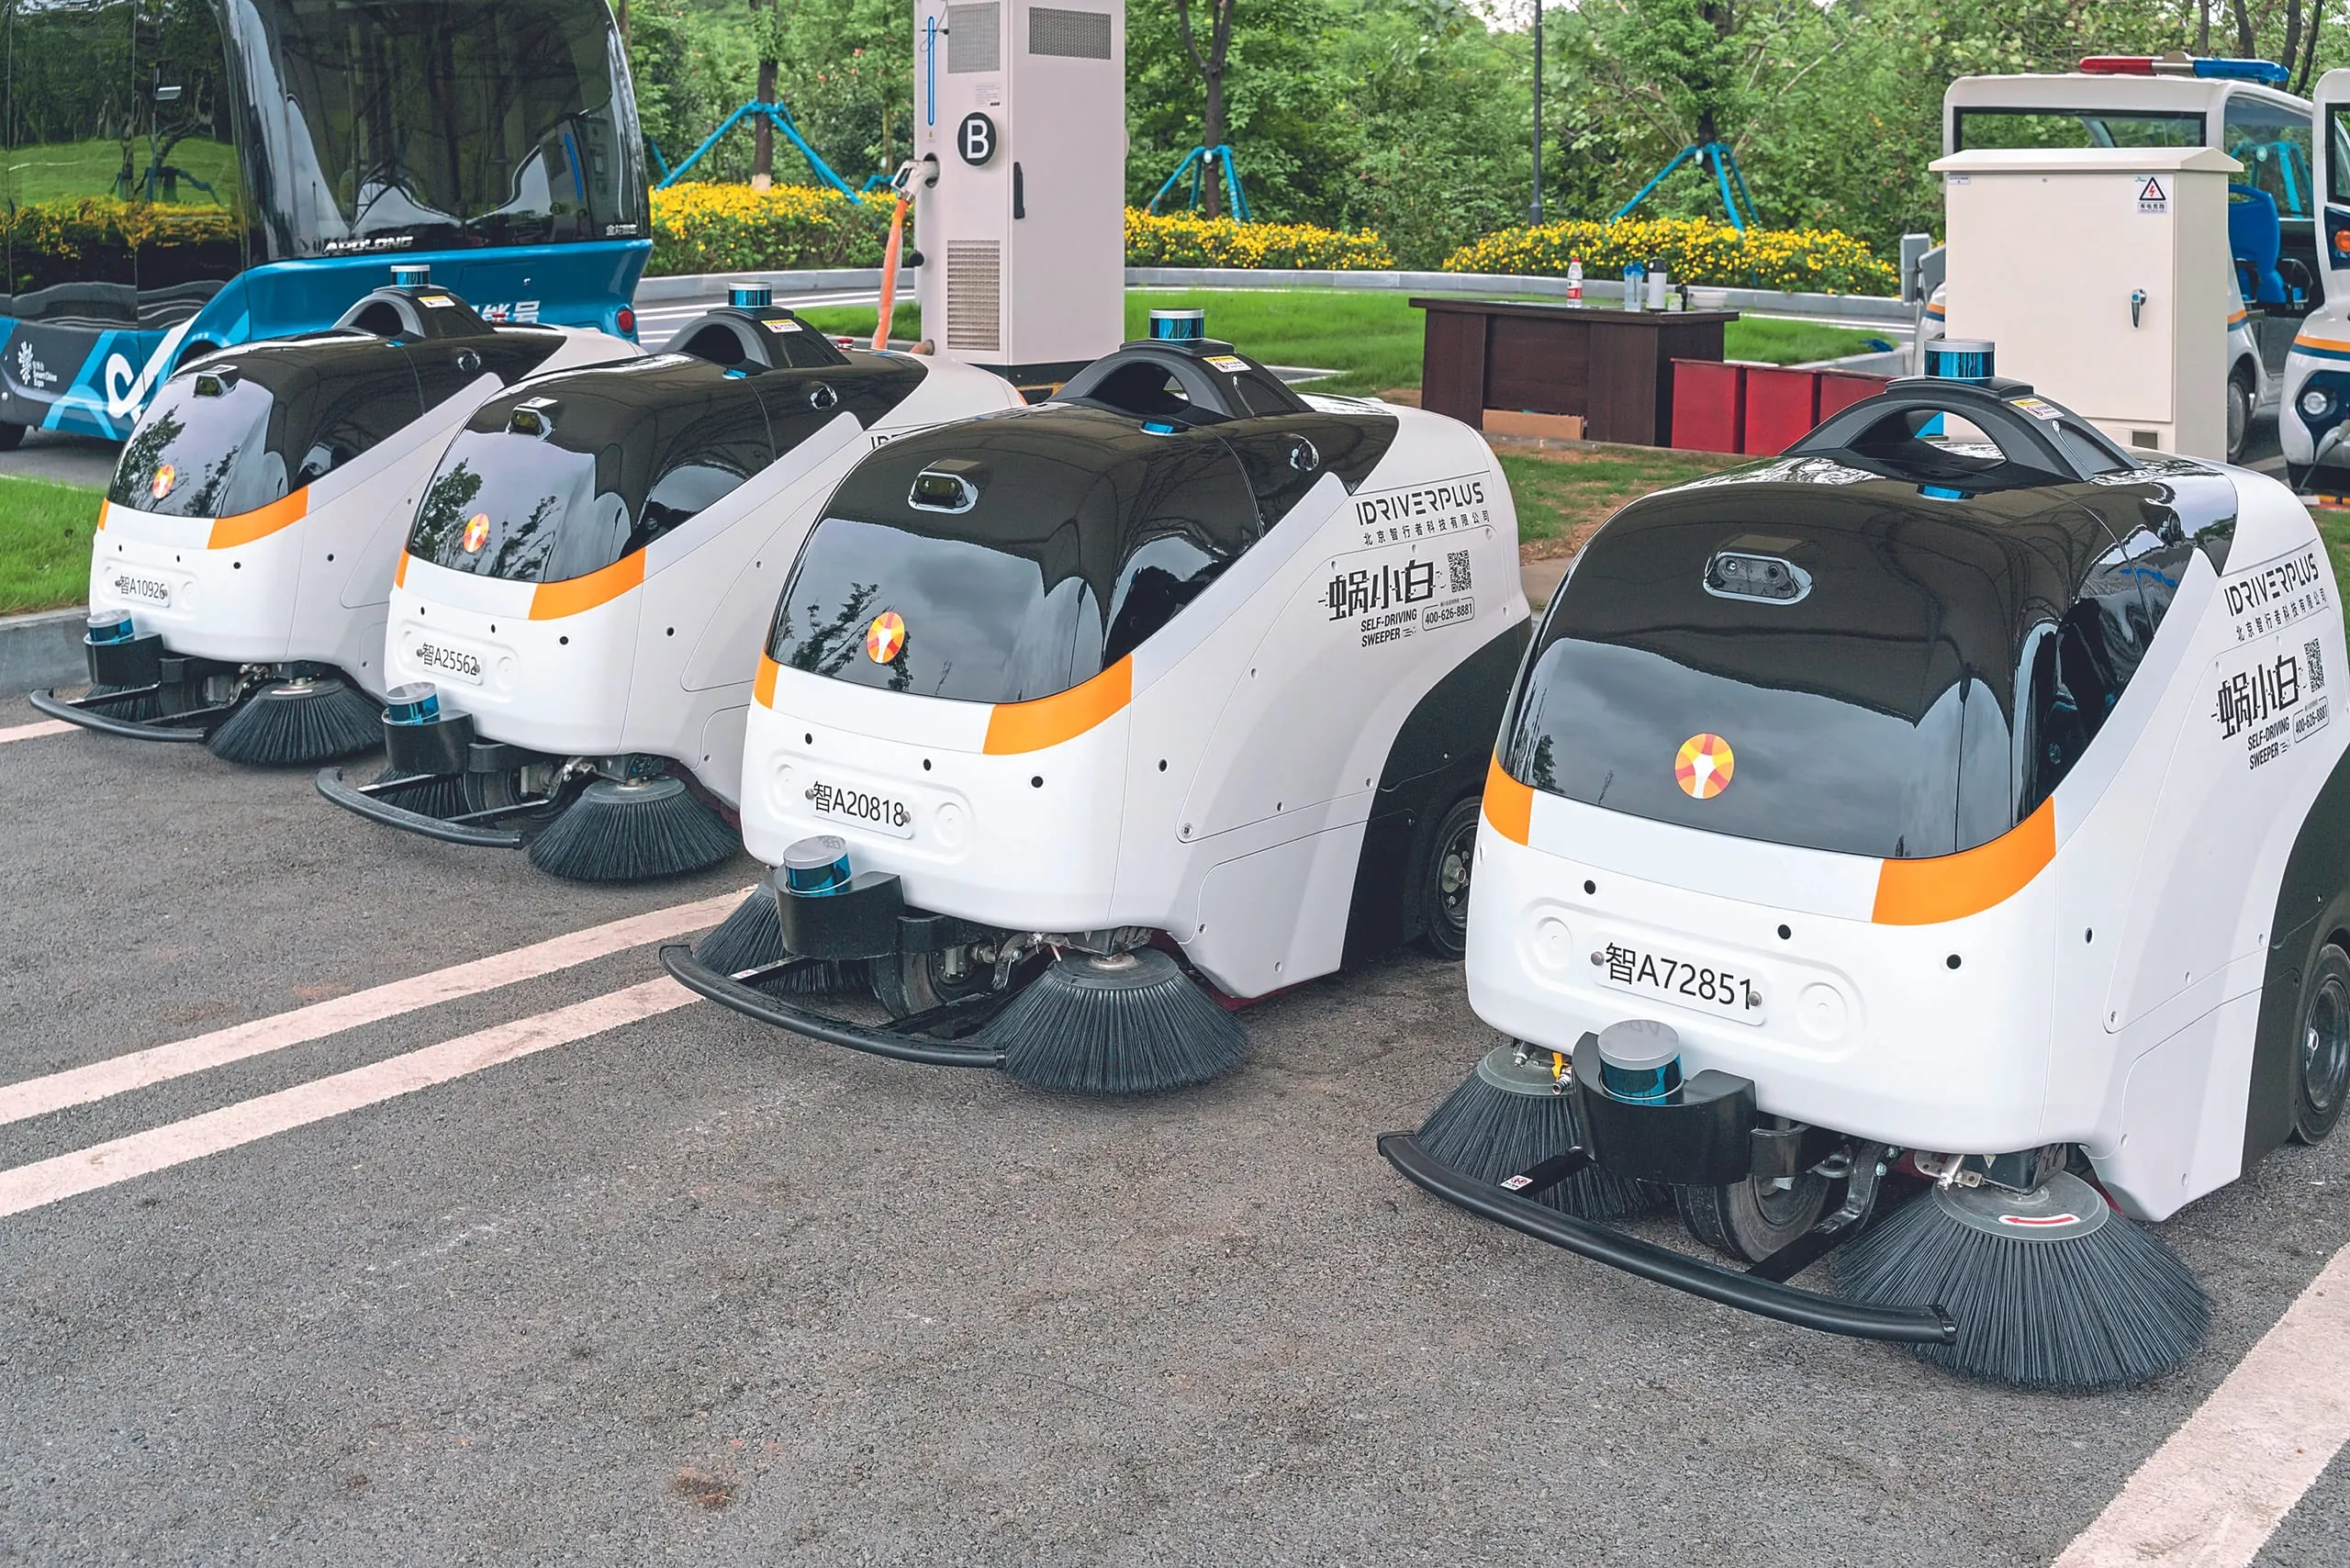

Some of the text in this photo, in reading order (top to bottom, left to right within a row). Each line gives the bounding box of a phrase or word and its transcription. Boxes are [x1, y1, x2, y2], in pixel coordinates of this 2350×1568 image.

[966, 119, 989, 159] B
[1356, 482, 1485, 526] IDRIVERPLUS
[1364, 510, 1491, 546] 北京智行者科技有限公司
[1328, 559, 1435, 622] 蜗小白
[2224, 553, 2320, 617] IDRIVERPLUS
[1360, 608, 1417, 633] SELF-DRIVING
[1425, 603, 1472, 625] 400-626-8881
[1361, 627, 1401, 647] SWEEPER
[422, 642, 477, 677] 智A25562
[2217, 654, 2300, 741] 蜗小白
[2247, 716, 2290, 752] SELF-DRIVING
[2249, 741, 2280, 770] SWEEPER
[813, 780, 905, 827] 智A20818
[1606, 942, 1751, 1011] 智A72851
